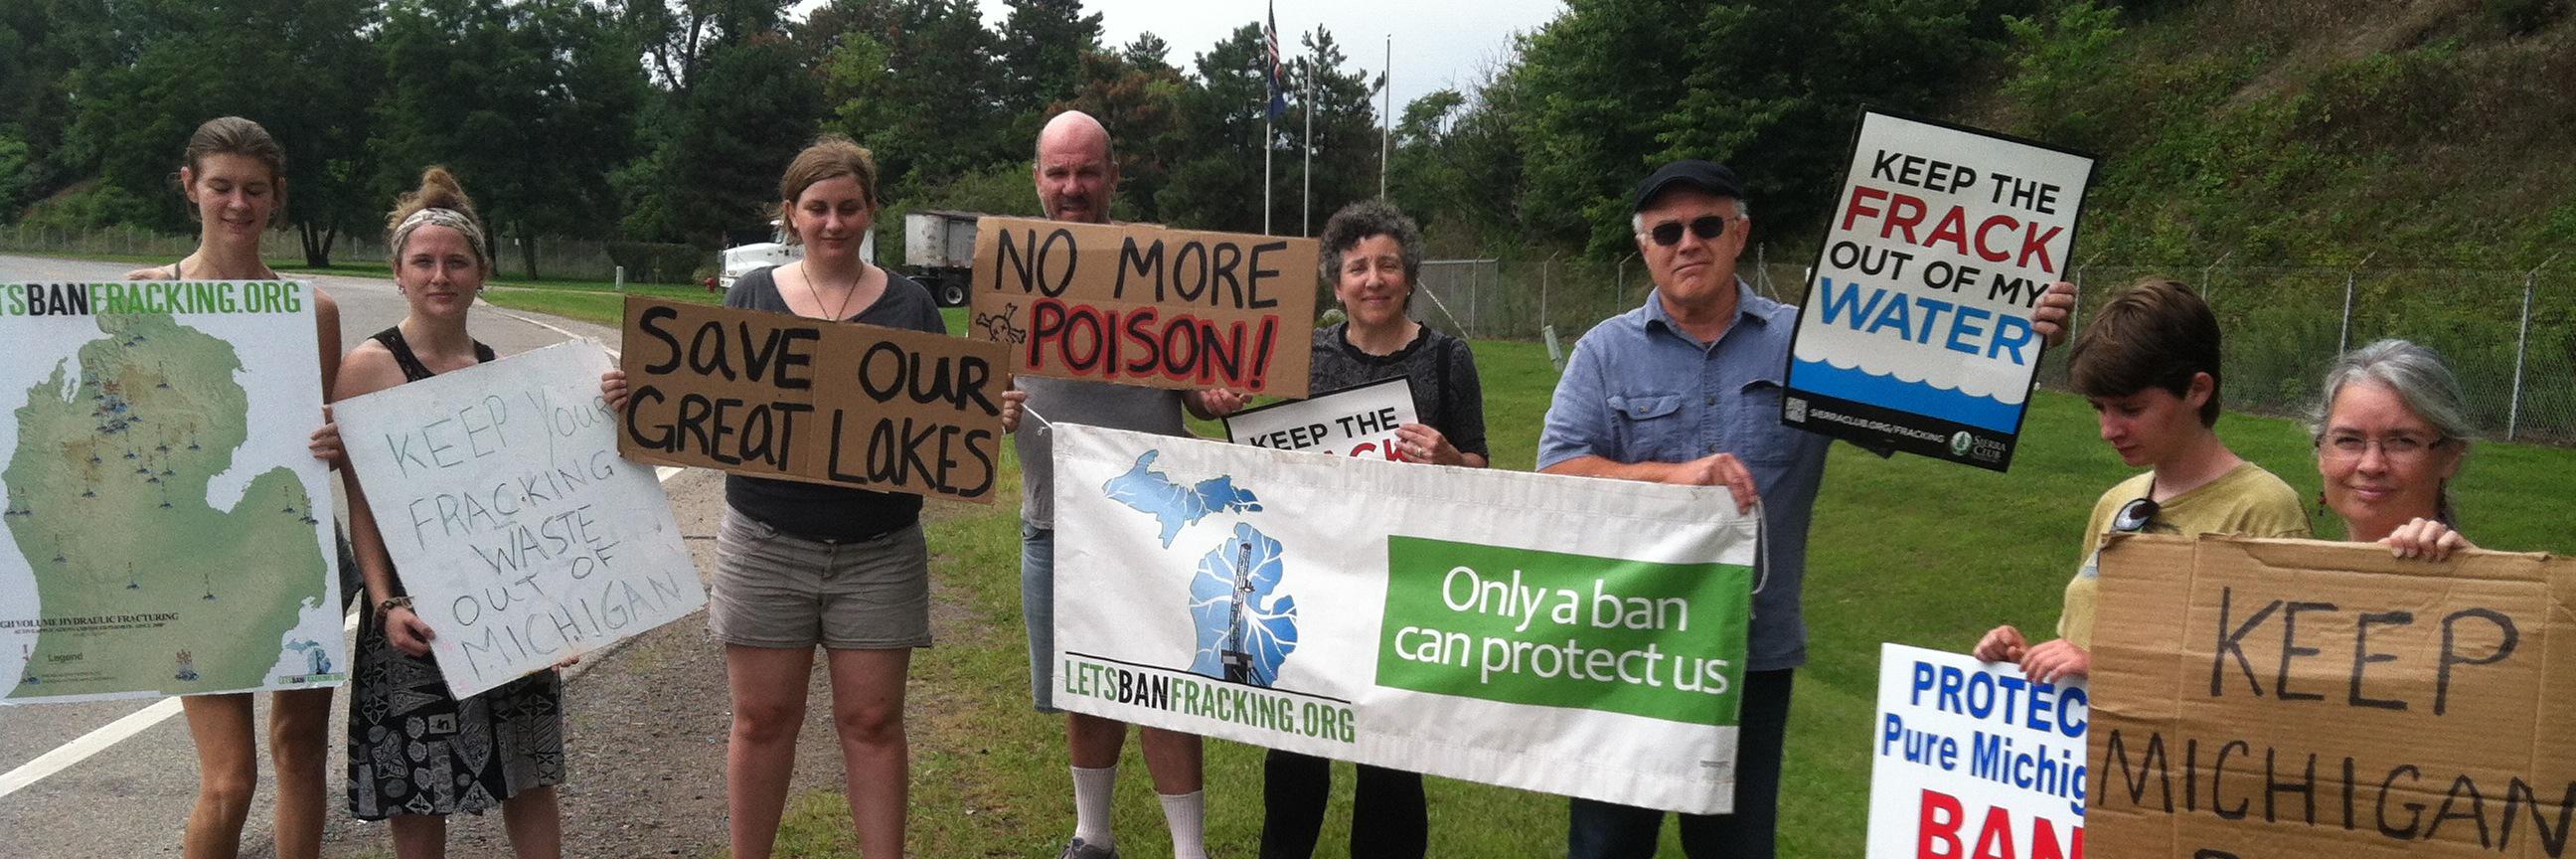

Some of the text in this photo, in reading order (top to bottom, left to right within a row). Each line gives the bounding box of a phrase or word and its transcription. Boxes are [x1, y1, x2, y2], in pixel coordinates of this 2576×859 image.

[1869, 149, 2061, 215] KEEP THE
[1841, 185, 2064, 273] FRACK
[995, 229, 1288, 309] NO MORE
[1830, 240, 2049, 309] OUT OF MY
[1028, 299, 1277, 391] POISON!
[1820, 276, 2033, 366] WATER
[858, 341, 1000, 417] OUR
[386, 394, 507, 479] KEEP
[1336, 407, 1400, 438] THE
[470, 504, 601, 576] WASTE
[60, 614, 115, 626] HYDRAULIC
[117, 612, 179, 623] FRACTURING
[452, 540, 620, 626] OUT OF
[1442, 565, 1689, 632] Only a ban
[48, 652, 83, 663] Legend
[460, 571, 683, 683] MICHIGAN
[1394, 625, 1730, 695] can protect us
[2209, 586, 2521, 716] KEEP
[1064, 659, 1356, 744] LETSBANFRACKING.ORG
[1881, 712, 1958, 772] Pure
[2098, 729, 2576, 859] MICHIGAN
